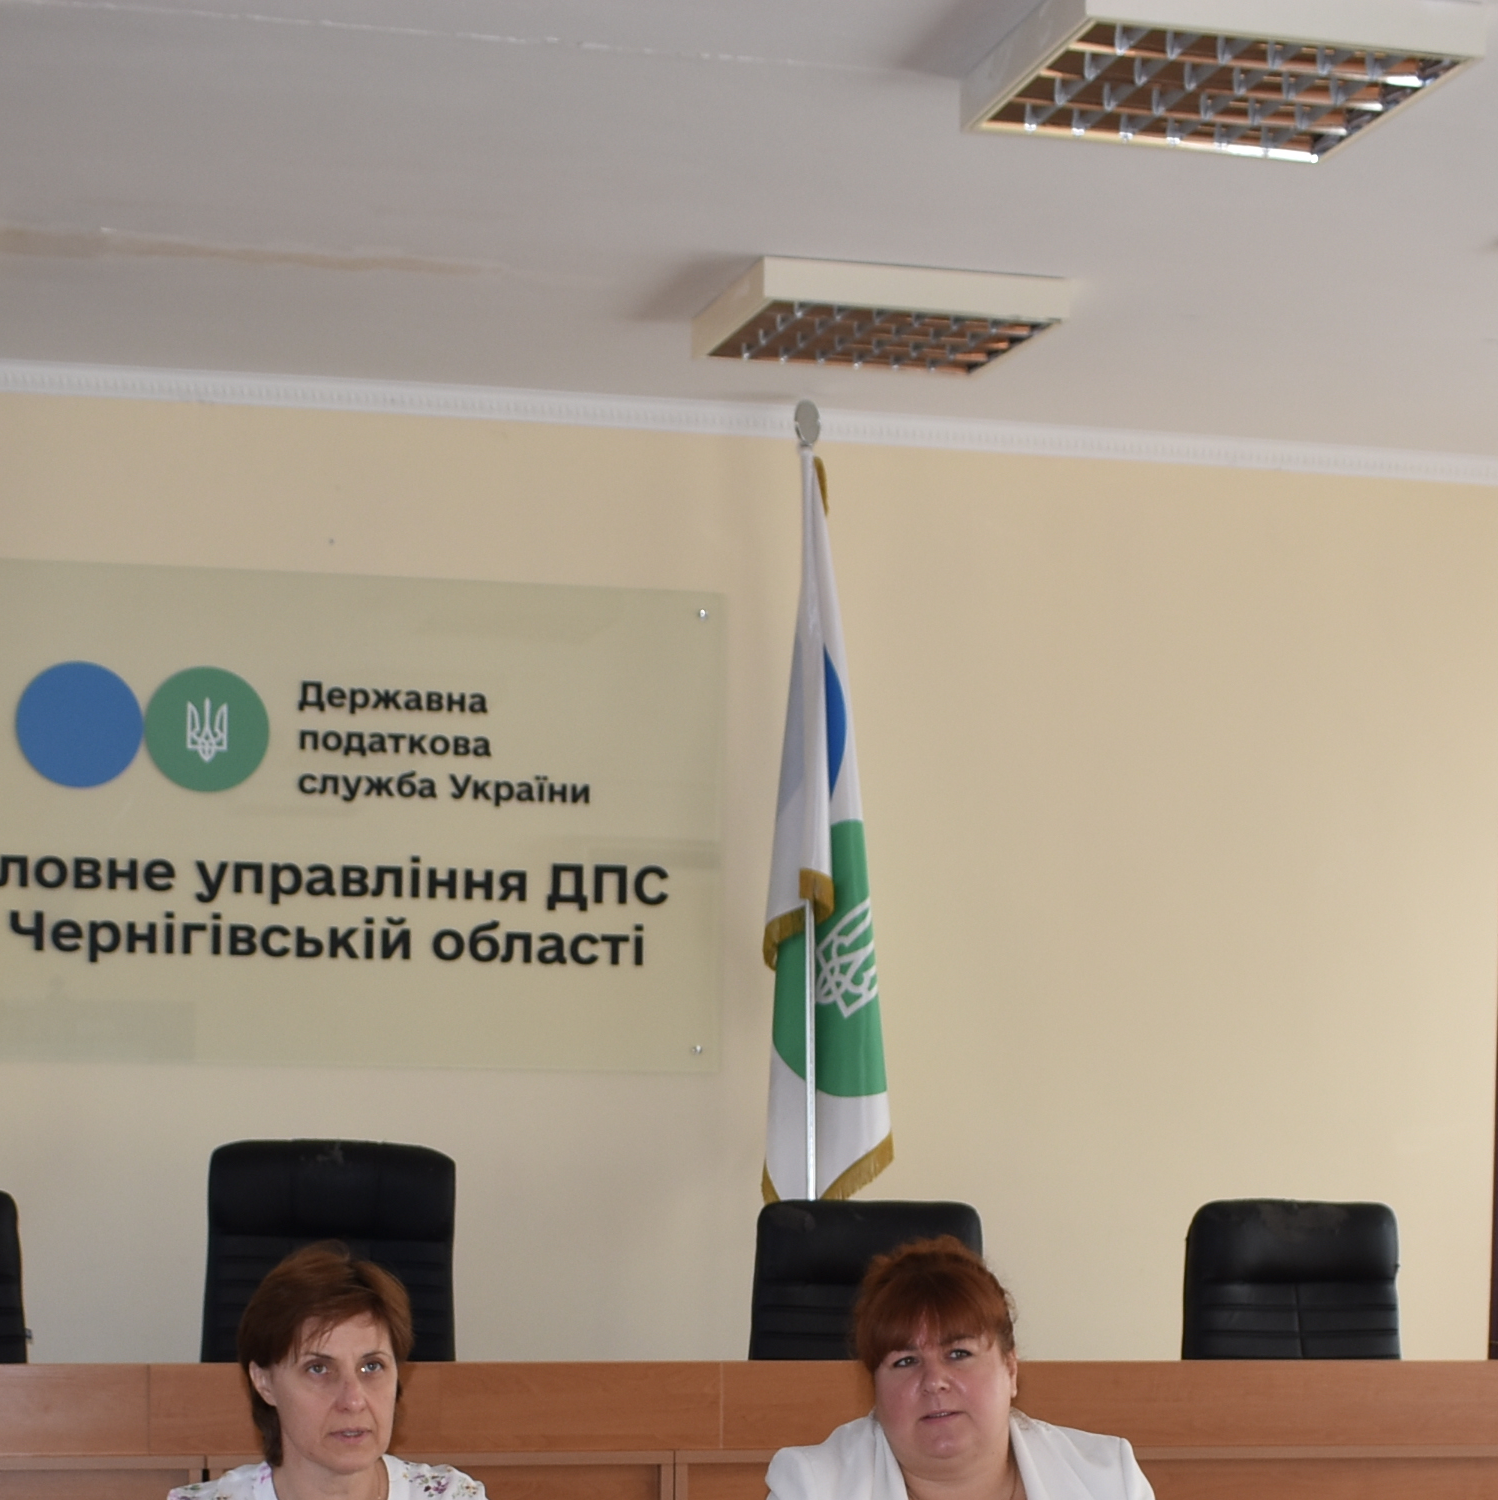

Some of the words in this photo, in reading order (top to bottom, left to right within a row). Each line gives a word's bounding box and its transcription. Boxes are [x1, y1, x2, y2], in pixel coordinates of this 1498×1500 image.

[296, 680, 489, 716] Державна
[297, 728, 493, 759] податкова
[296, 770, 439, 804] служба
[448, 773, 592, 809] України
[193, 855, 529, 907] управління
[545, 863, 670, 914] ДПС
[7, 909, 412, 965] Чернігівській
[430, 919, 645, 968] області
